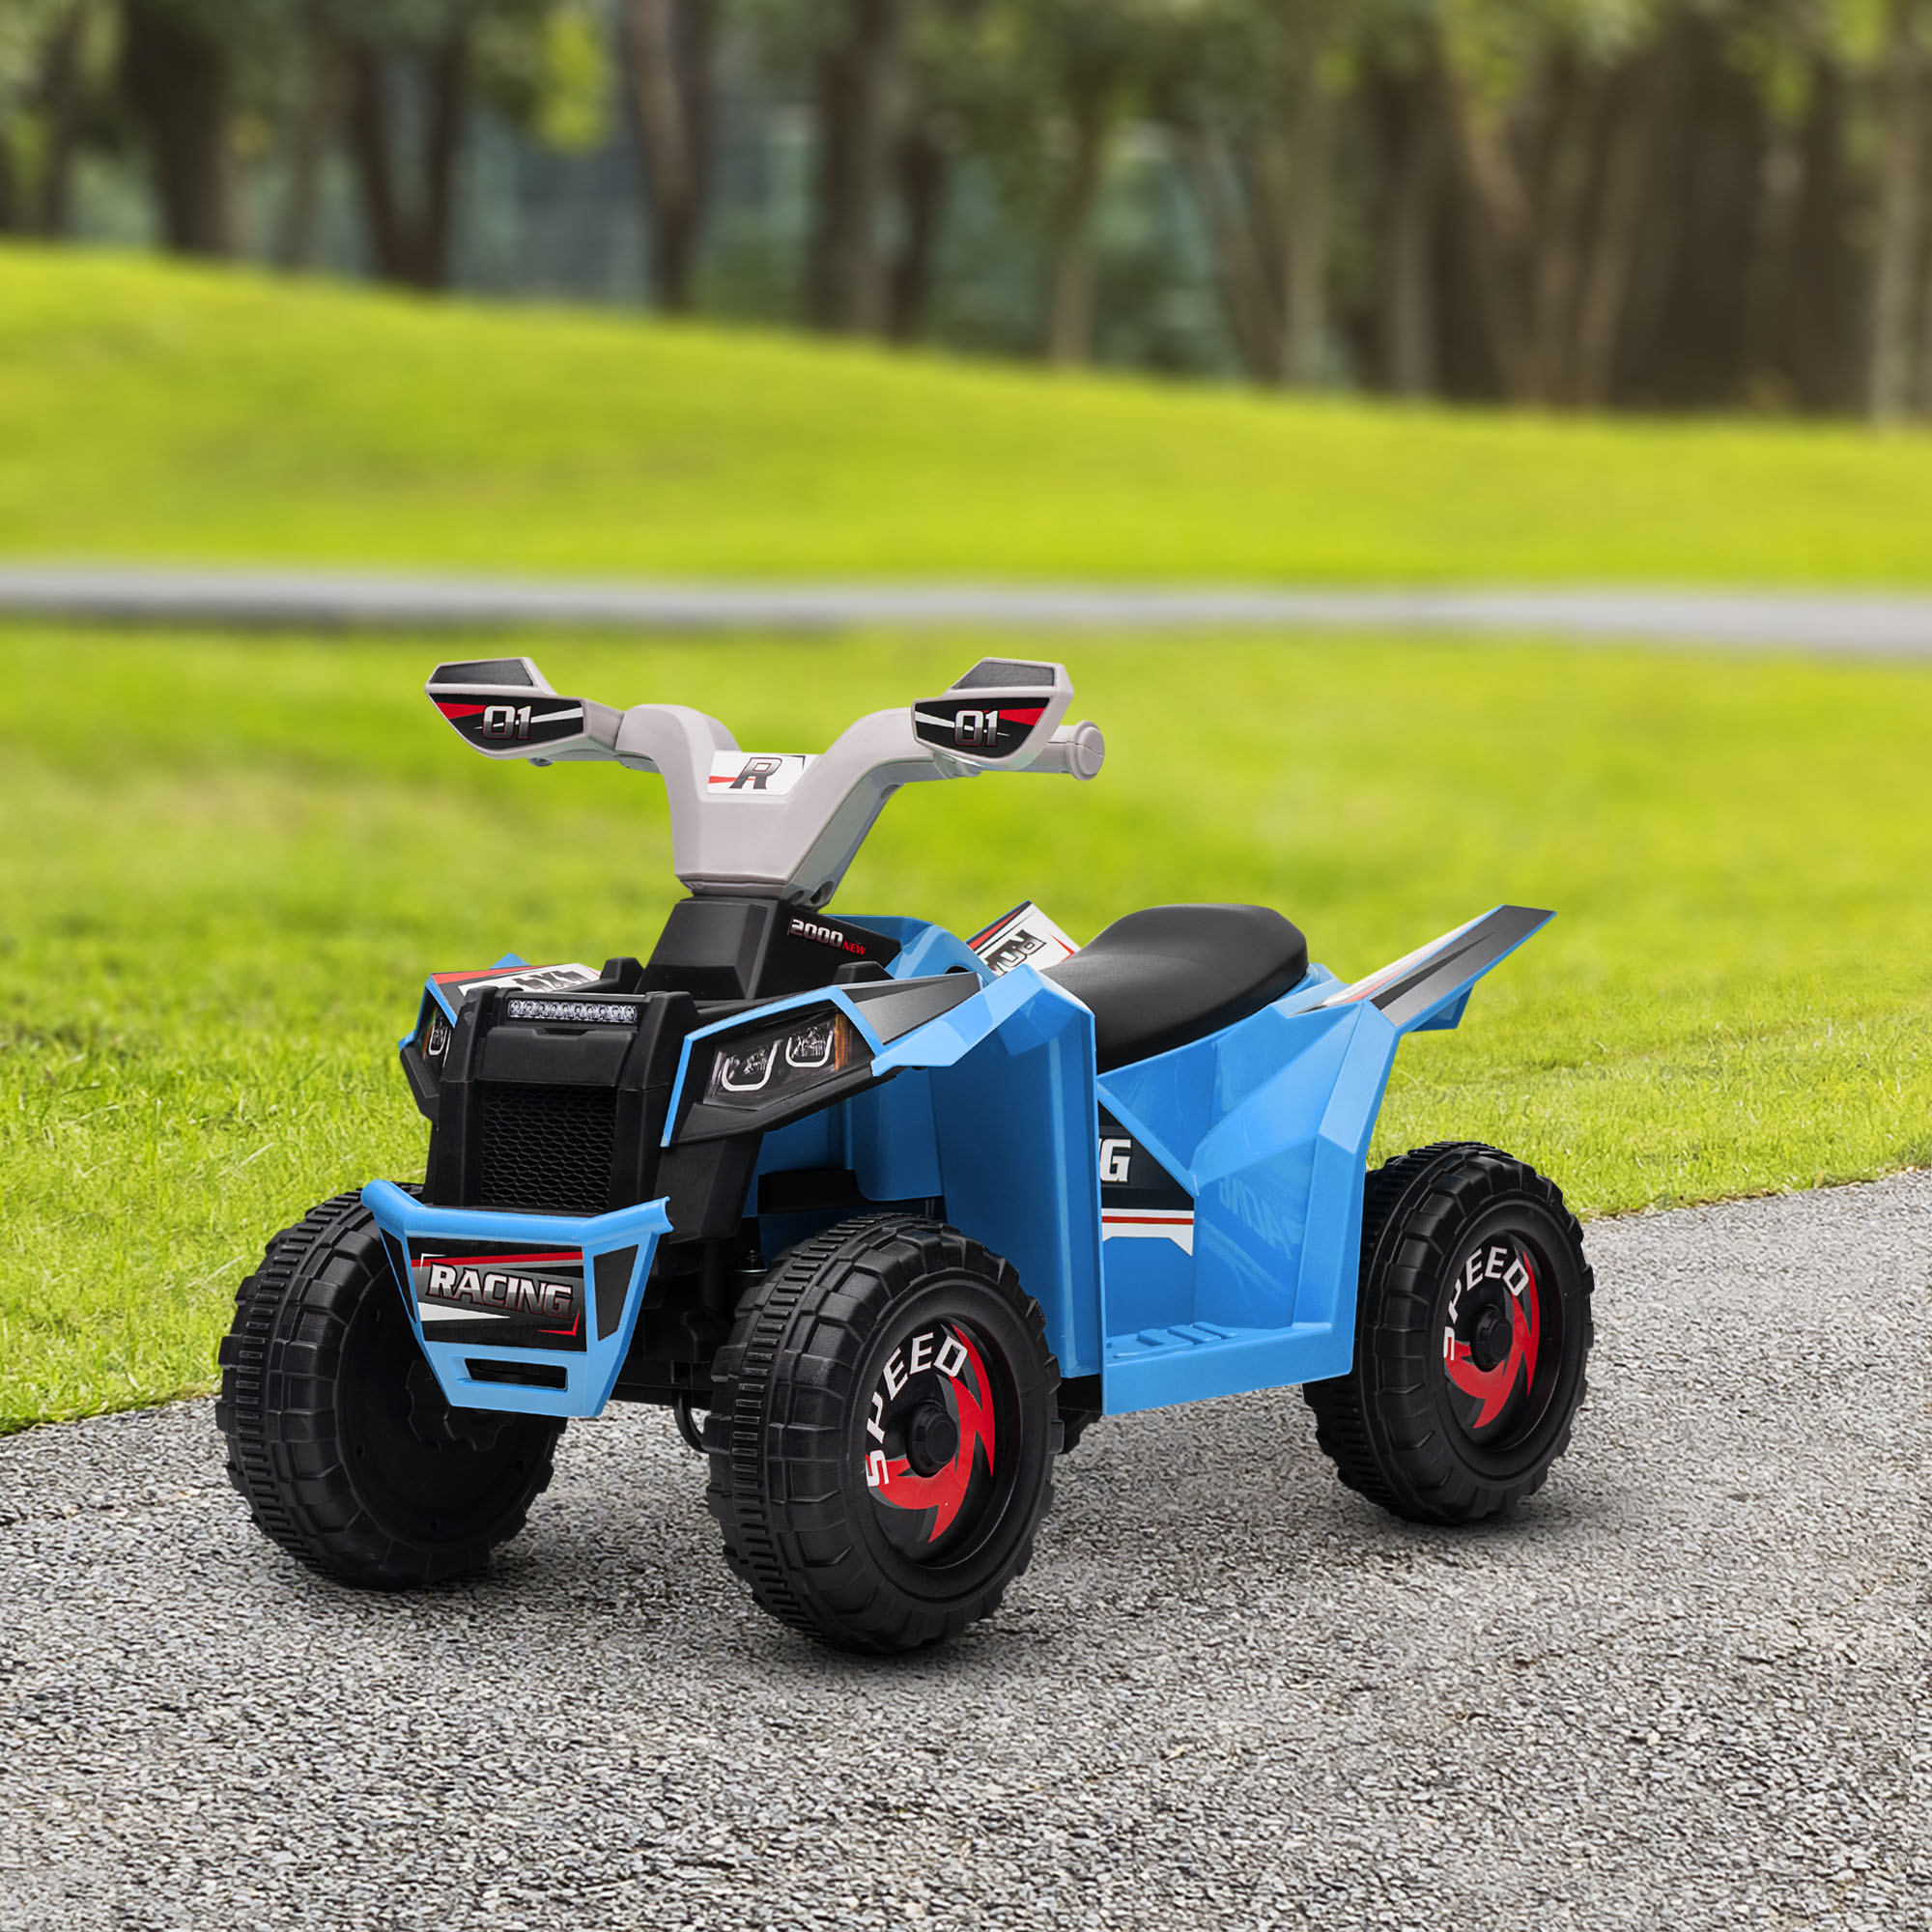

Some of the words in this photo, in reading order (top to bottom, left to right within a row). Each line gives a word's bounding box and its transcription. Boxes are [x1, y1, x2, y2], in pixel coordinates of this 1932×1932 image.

[483, 705, 532, 740] 01
[953, 709, 999, 747] 01
[728, 756, 782, 789] R
[790, 918, 843, 948] 2000
[841, 940, 867, 955] NEW
[1098, 1138, 1131, 1182] G
[425, 1262, 573, 1320] RACING
[1443, 1245, 1529, 1361] SPEED
[866, 1332, 968, 1487] SPEED
